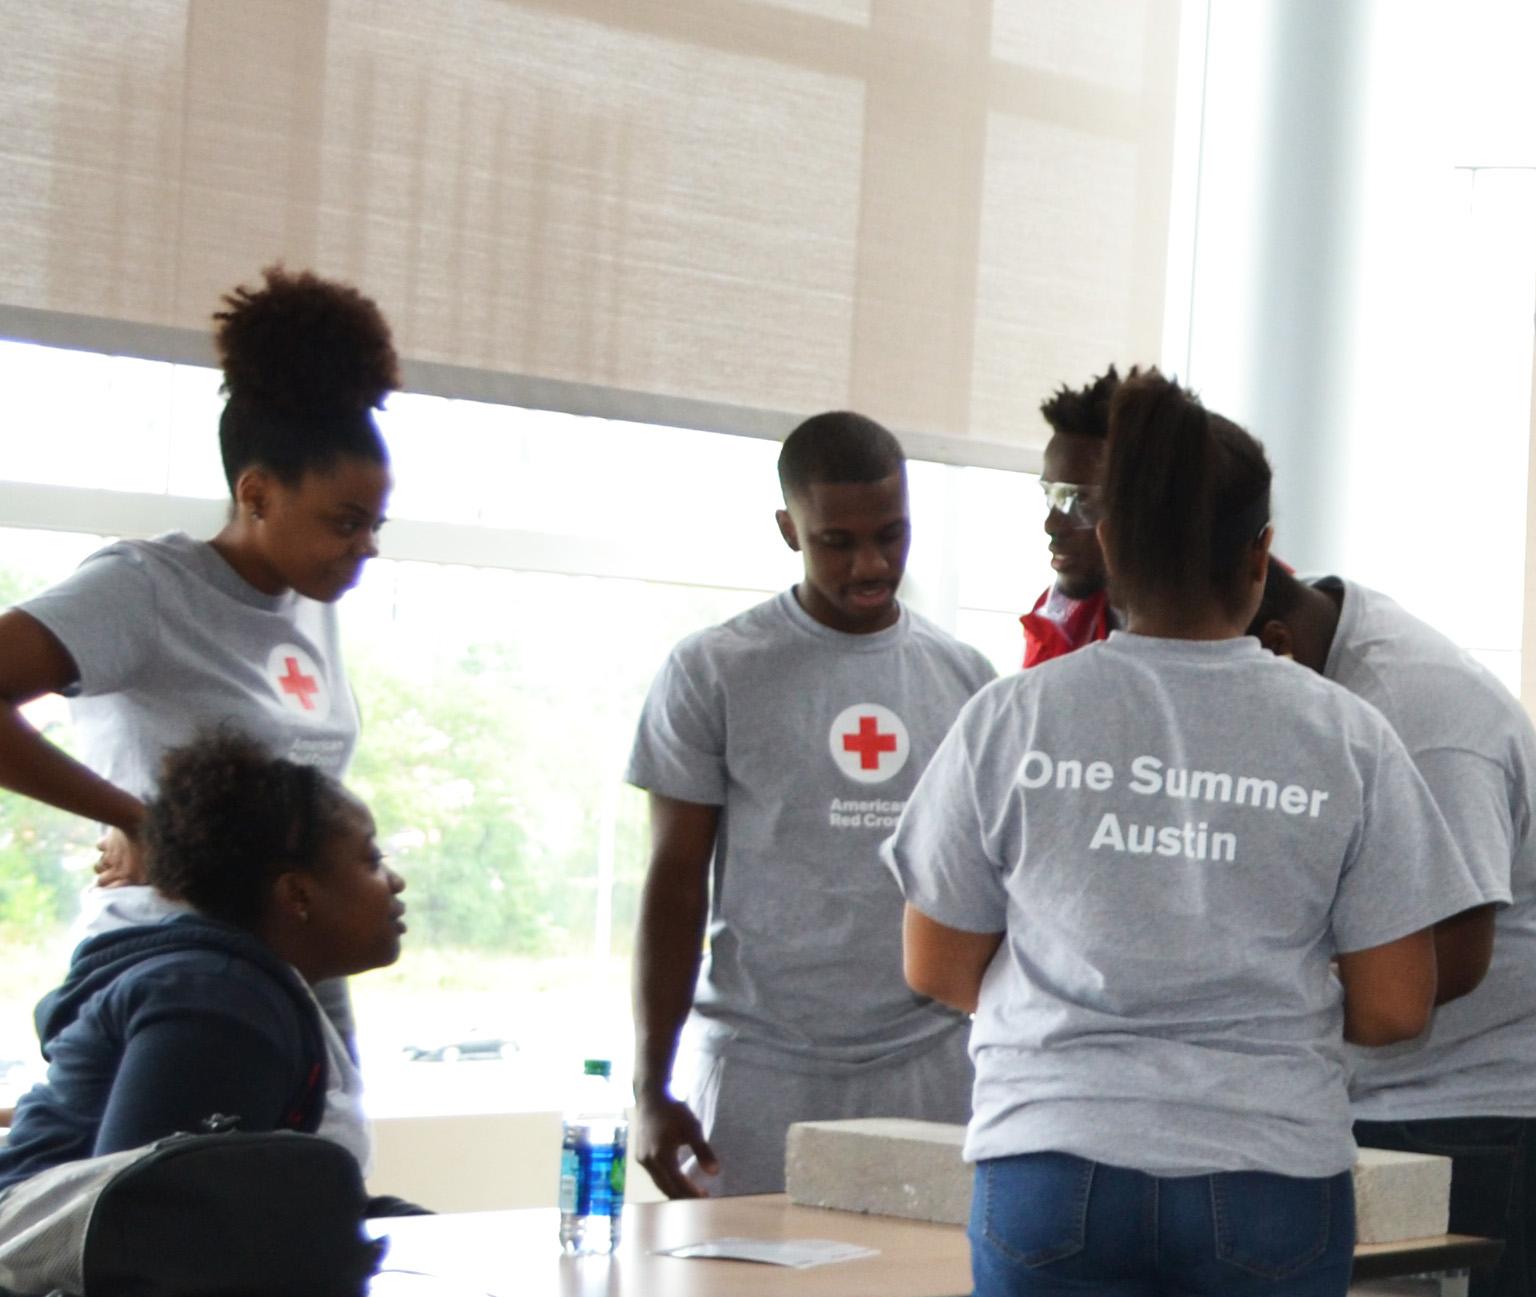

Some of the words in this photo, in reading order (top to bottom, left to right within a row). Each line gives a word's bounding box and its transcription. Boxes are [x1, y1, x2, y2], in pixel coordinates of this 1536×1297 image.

[1017, 750, 1115, 791] One
[1129, 755, 1329, 818] Summer
[829, 812, 861, 827] Red
[863, 813, 901, 827] Cro
[1089, 813, 1237, 862] Austin
